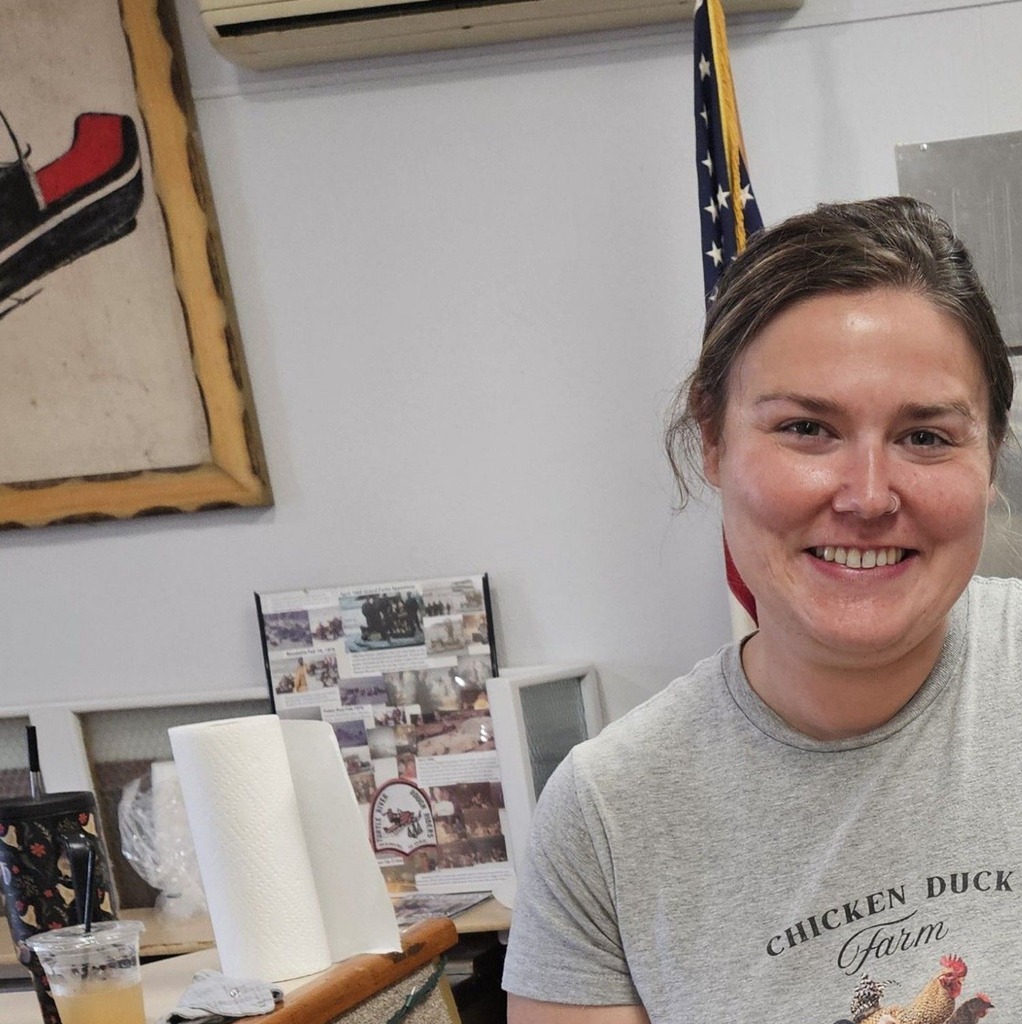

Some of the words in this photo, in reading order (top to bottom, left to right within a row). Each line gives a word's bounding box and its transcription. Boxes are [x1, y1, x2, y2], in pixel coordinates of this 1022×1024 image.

[766, 884, 907, 957] CHICKEN
[926, 870, 1014, 899] DUCK
[837, 909, 949, 976] Farm
